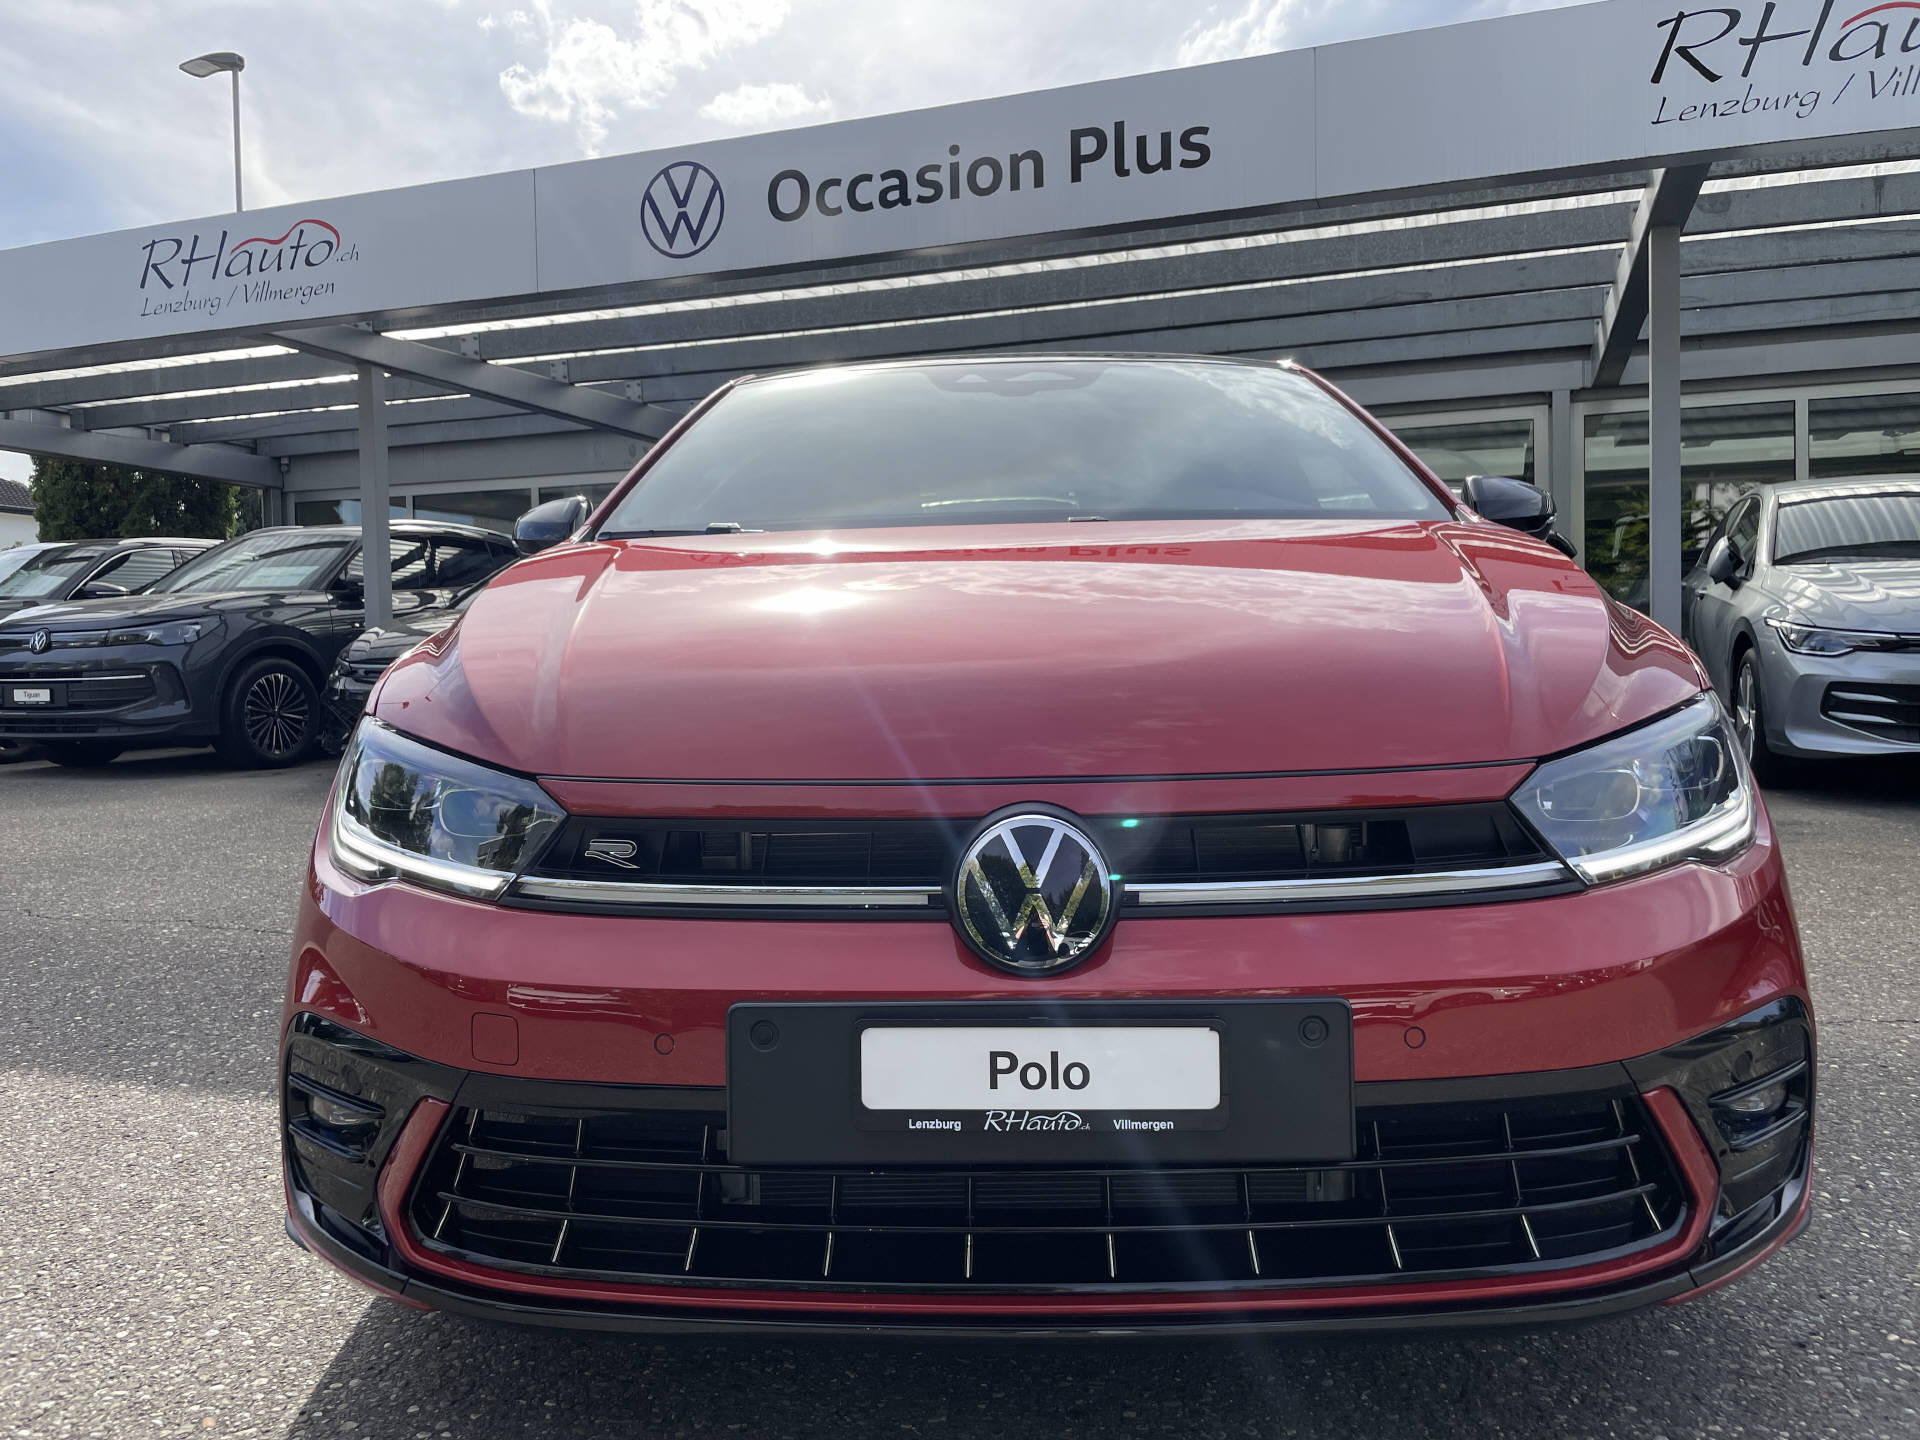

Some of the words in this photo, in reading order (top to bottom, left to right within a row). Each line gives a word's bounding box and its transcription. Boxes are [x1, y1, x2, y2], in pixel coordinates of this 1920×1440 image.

[1650, 83, 1822, 125] Lenzburg
[767, 144, 1045, 222] Occasion
[1070, 120, 1212, 184] Plus
[140, 291, 222, 317] Lenzburg
[243, 279, 336, 305] Villmergen
[988, 1050, 1091, 1091] Polo
[908, 1118, 962, 1131] Lenzburg
[1113, 1118, 1174, 1131] Villmergen
